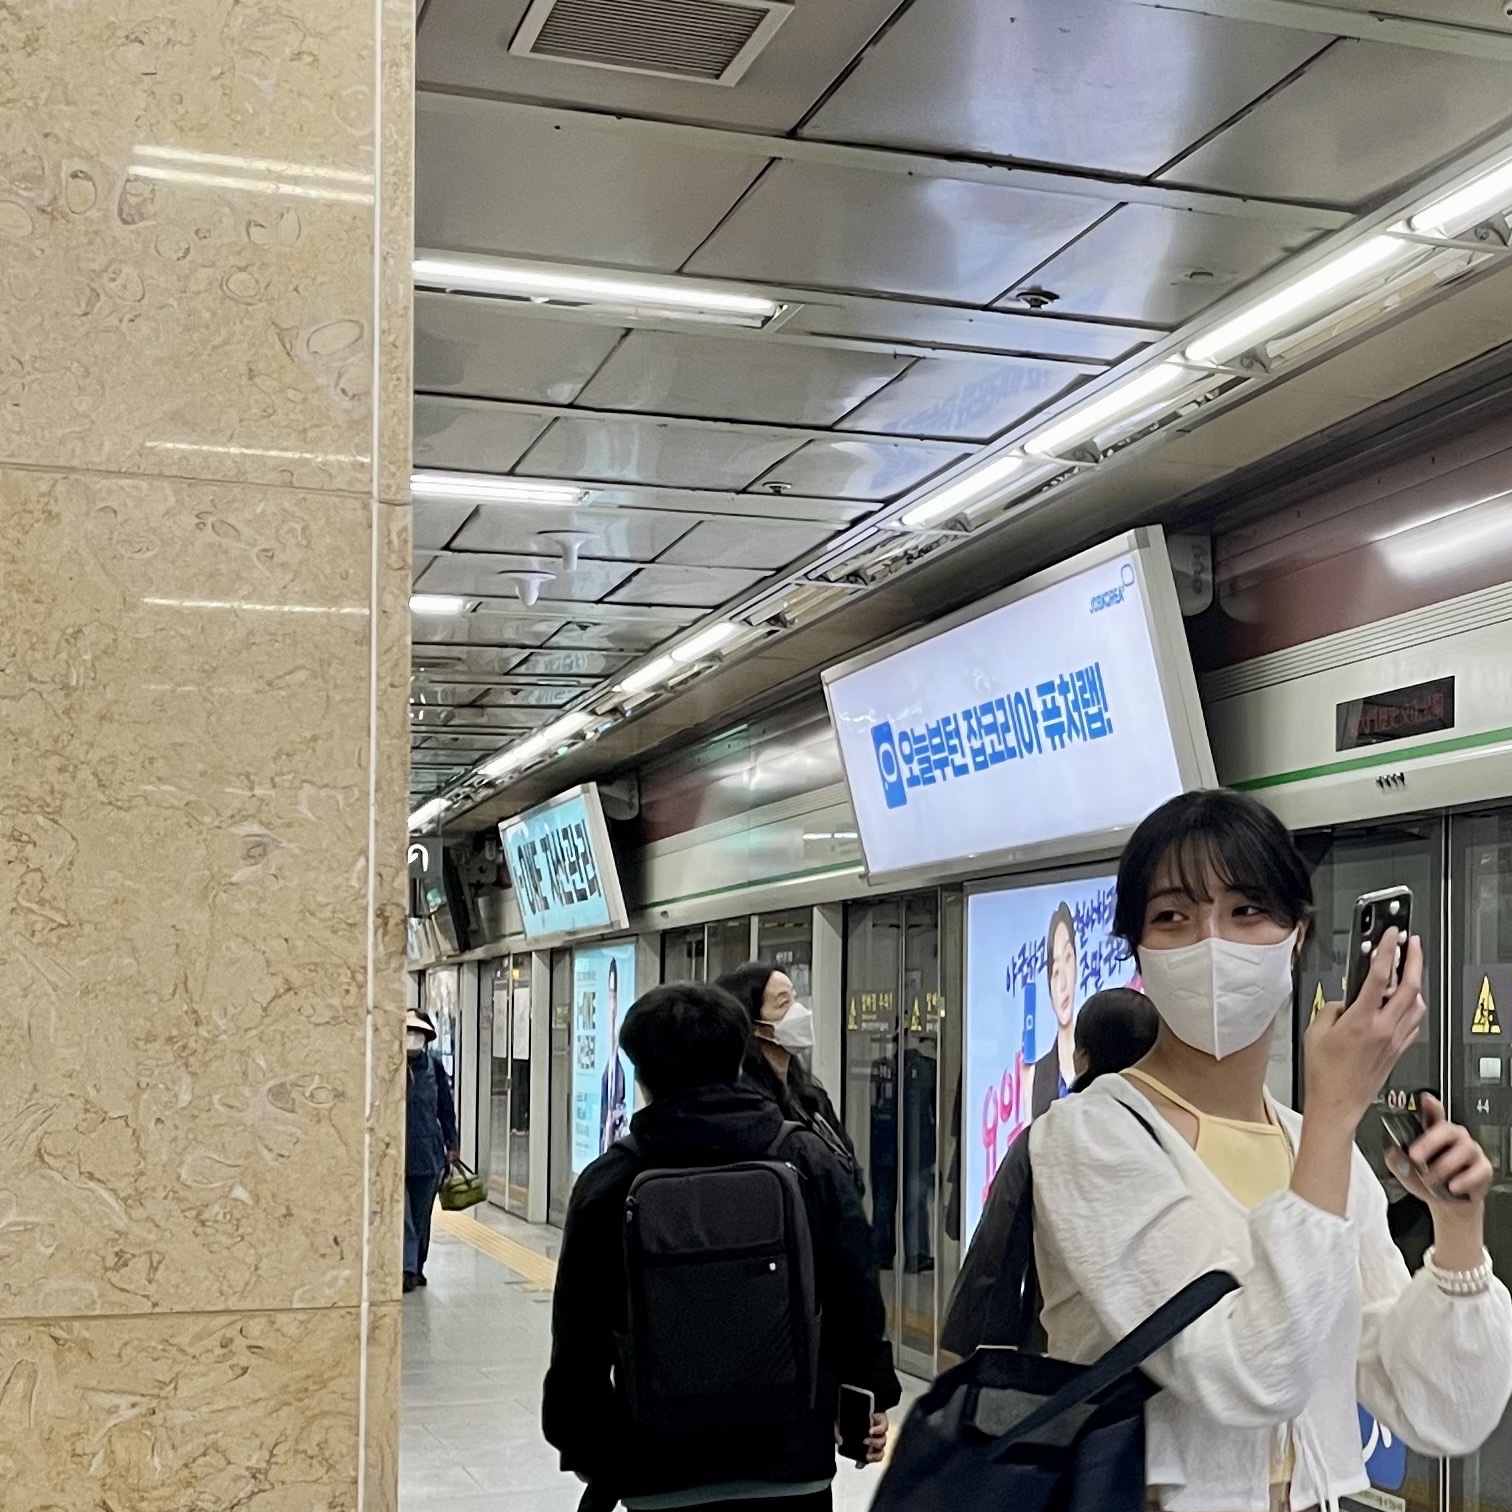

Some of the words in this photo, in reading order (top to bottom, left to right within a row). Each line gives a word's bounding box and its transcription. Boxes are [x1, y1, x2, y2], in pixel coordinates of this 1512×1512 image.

[899, 713, 970, 788] 오늘부턴
[961, 685, 1043, 773] 잡코리아
[1035, 661, 1114, 751] 퓨처랩!
